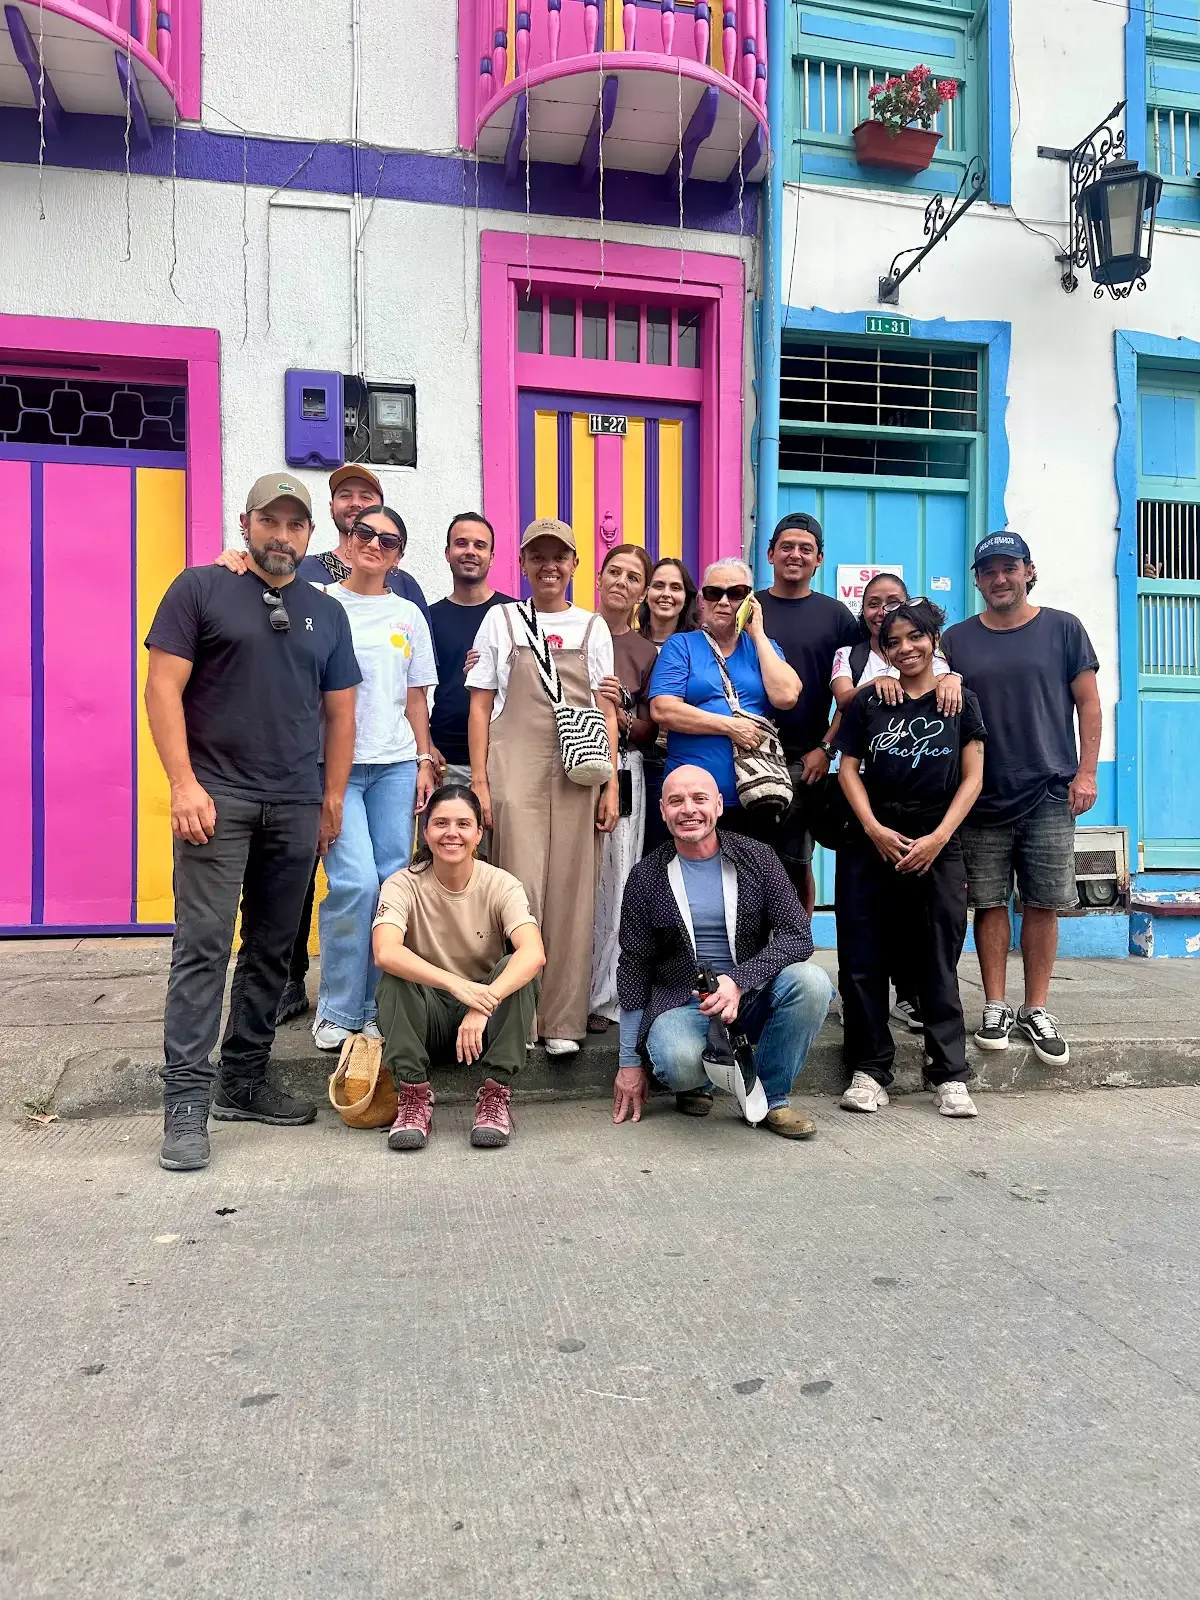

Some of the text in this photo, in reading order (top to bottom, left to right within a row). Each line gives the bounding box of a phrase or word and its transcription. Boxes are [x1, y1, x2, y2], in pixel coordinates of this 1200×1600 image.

[870, 319, 905, 333] 11-31
[592, 416, 625, 433] 11-27
[880, 717, 909, 747] Yo
[869, 732, 952, 769] Pacífico
